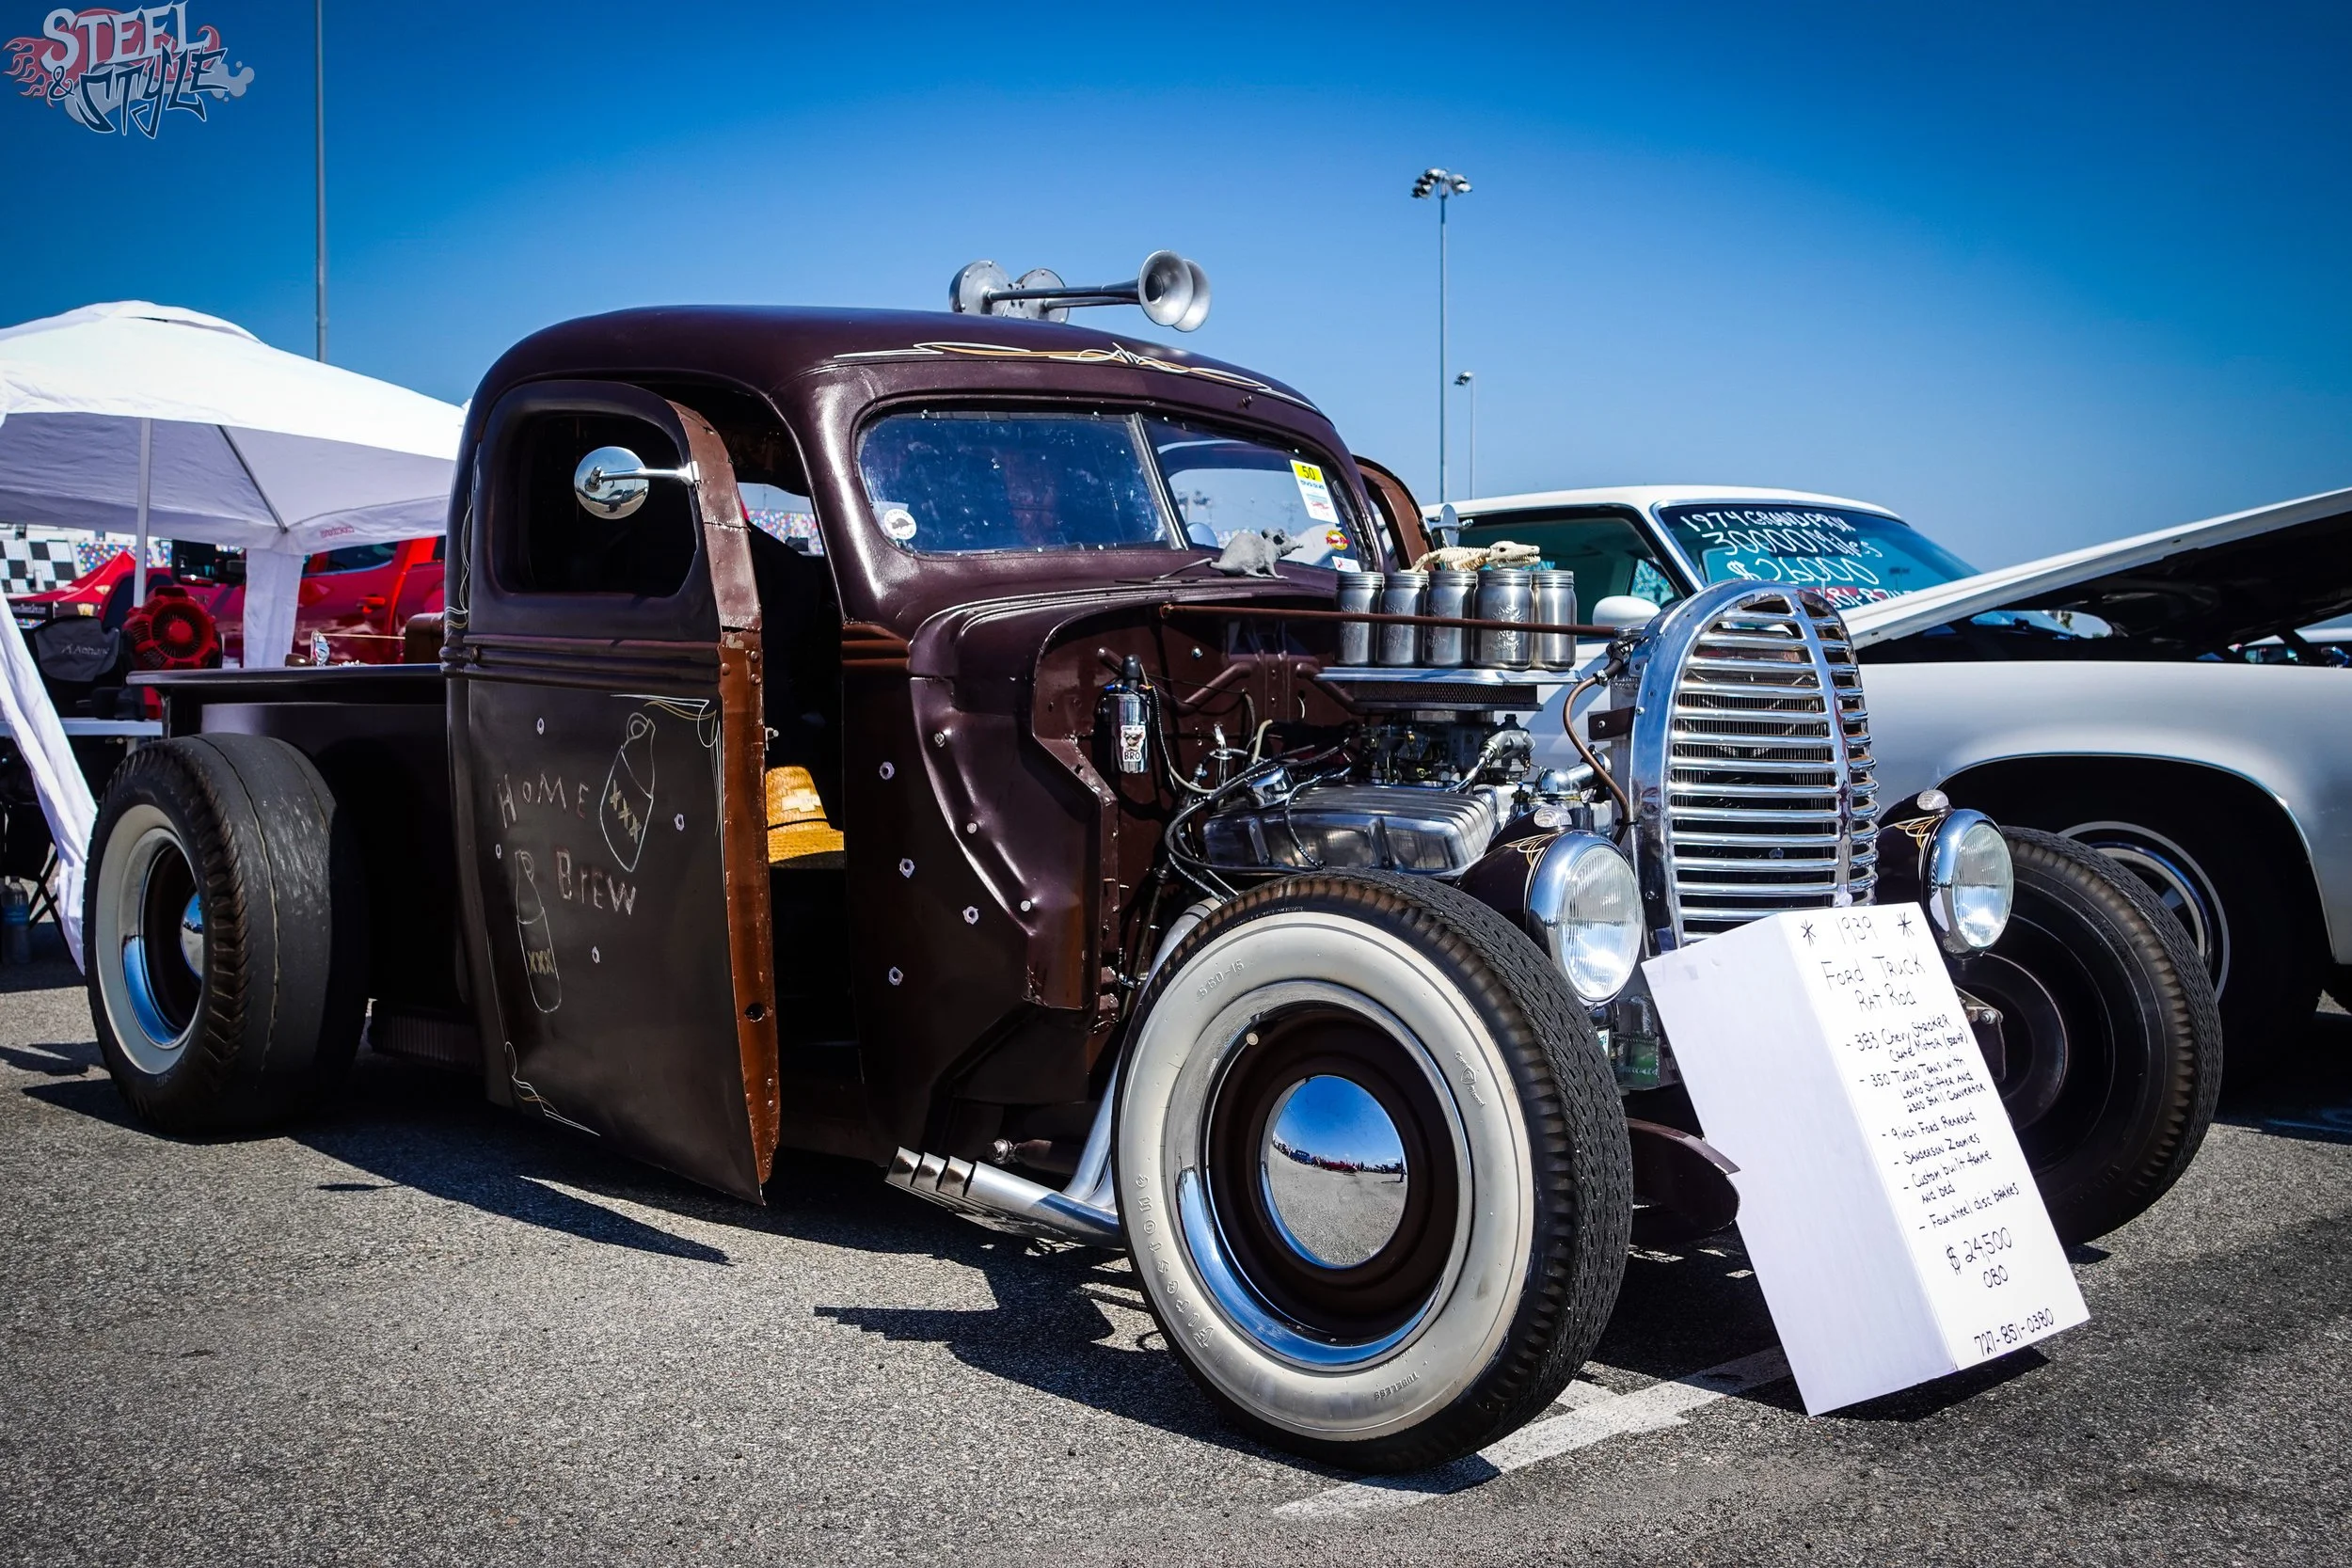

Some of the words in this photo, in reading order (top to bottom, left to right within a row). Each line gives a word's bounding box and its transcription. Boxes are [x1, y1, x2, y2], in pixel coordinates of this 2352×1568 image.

[1302, 466, 1316, 481] 50
[1680, 511, 1749, 531] 1974
[1124, 752, 1141, 761] BRO
[1836, 915, 1879, 944] 1939
[1854, 1031, 1880, 1052] 383
[1870, 1073, 1890, 1087] 350
[1946, 1054, 1966, 1069] with
[1936, 1180, 1956, 1197] bed
[1974, 1192, 1993, 1211] disc
[1136, 1174, 1215, 1349] Firestone
[1974, 1307, 2054, 1357] 727-851-0380
[1374, 1370, 1420, 1402] TUBELESS
